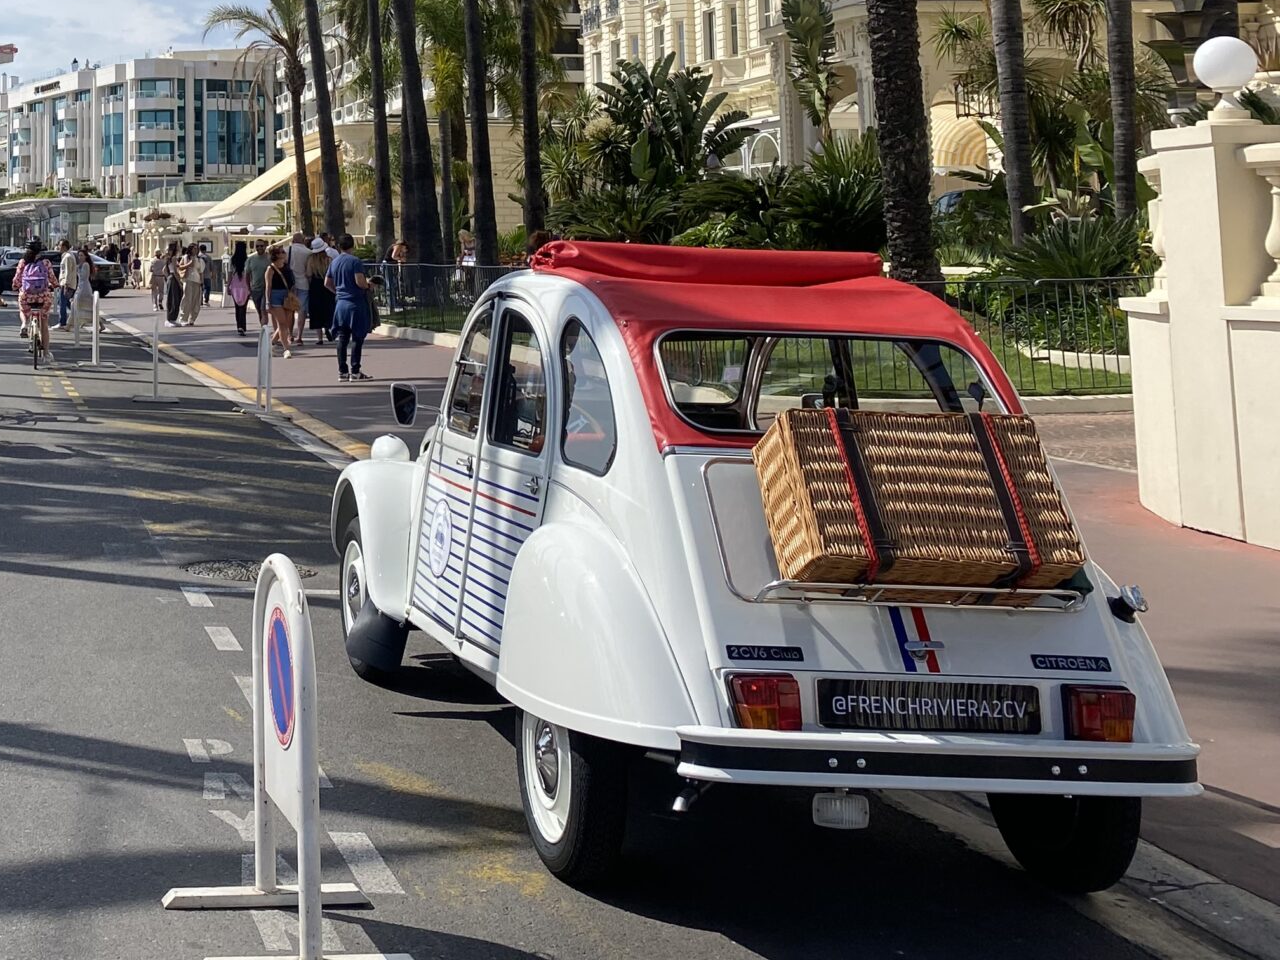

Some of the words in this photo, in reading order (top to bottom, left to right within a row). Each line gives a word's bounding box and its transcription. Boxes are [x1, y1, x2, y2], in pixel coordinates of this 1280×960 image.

[730, 646, 768, 659] 2CV6
[770, 648, 800, 659] Club
[832, 695, 1027, 719] @FRENCHRIVIERA2CV
